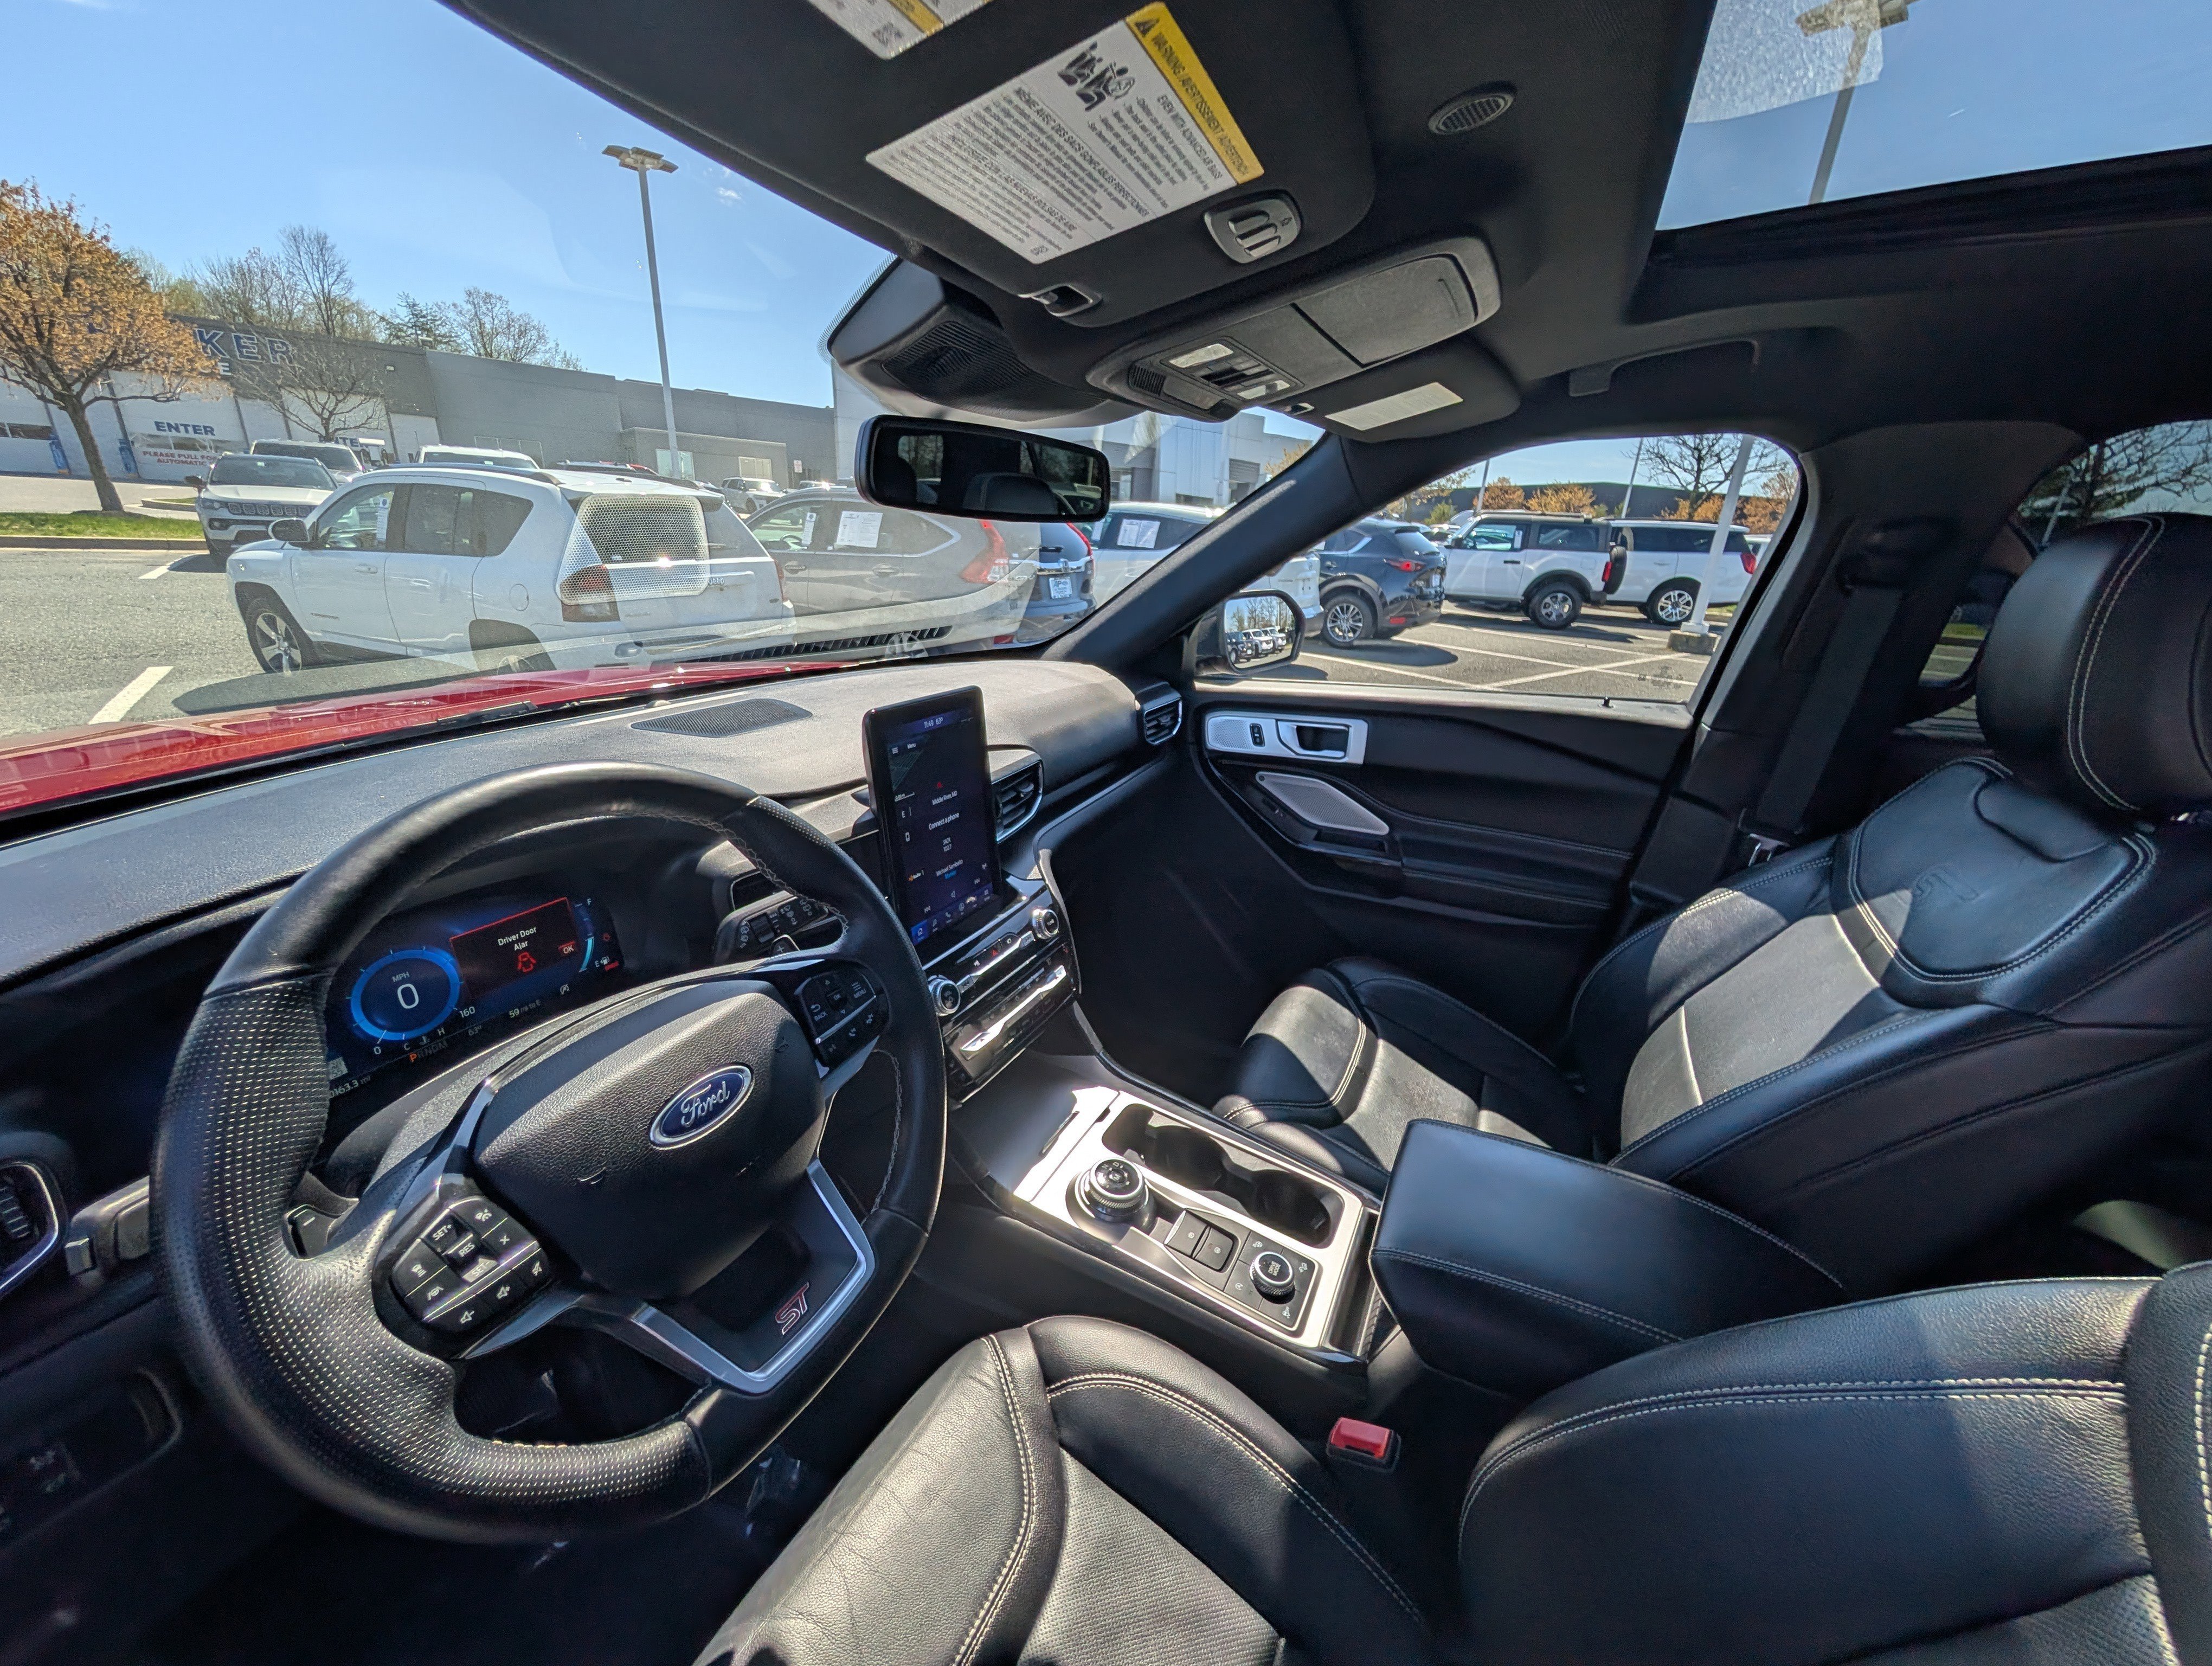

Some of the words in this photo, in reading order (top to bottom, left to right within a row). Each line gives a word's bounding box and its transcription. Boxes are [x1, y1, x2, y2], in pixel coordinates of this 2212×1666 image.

[195, 328, 296, 367] KER
[154, 421, 216, 436] ENTER
[928, 818, 945, 830] Connect
[948, 812, 960, 823] phone
[497, 933, 519, 946] Driver
[519, 926, 537, 938] Door
[514, 940, 529, 951] Ajar
[563, 945, 574, 954] OK
[392, 970, 410, 983] MPH
[397, 983, 420, 1009] 0
[459, 1006, 475, 1018] 160
[509, 1008, 520, 1018] 59
[814, 1011, 827, 1021] BACK
[437, 1027, 446, 1036] H
[373, 1046, 382, 1055] 0
[403, 1042, 411, 1050] C
[680, 1081, 731, 1128] Ford
[458, 1242, 475, 1258] RES
[774, 1281, 810, 1336] ST
